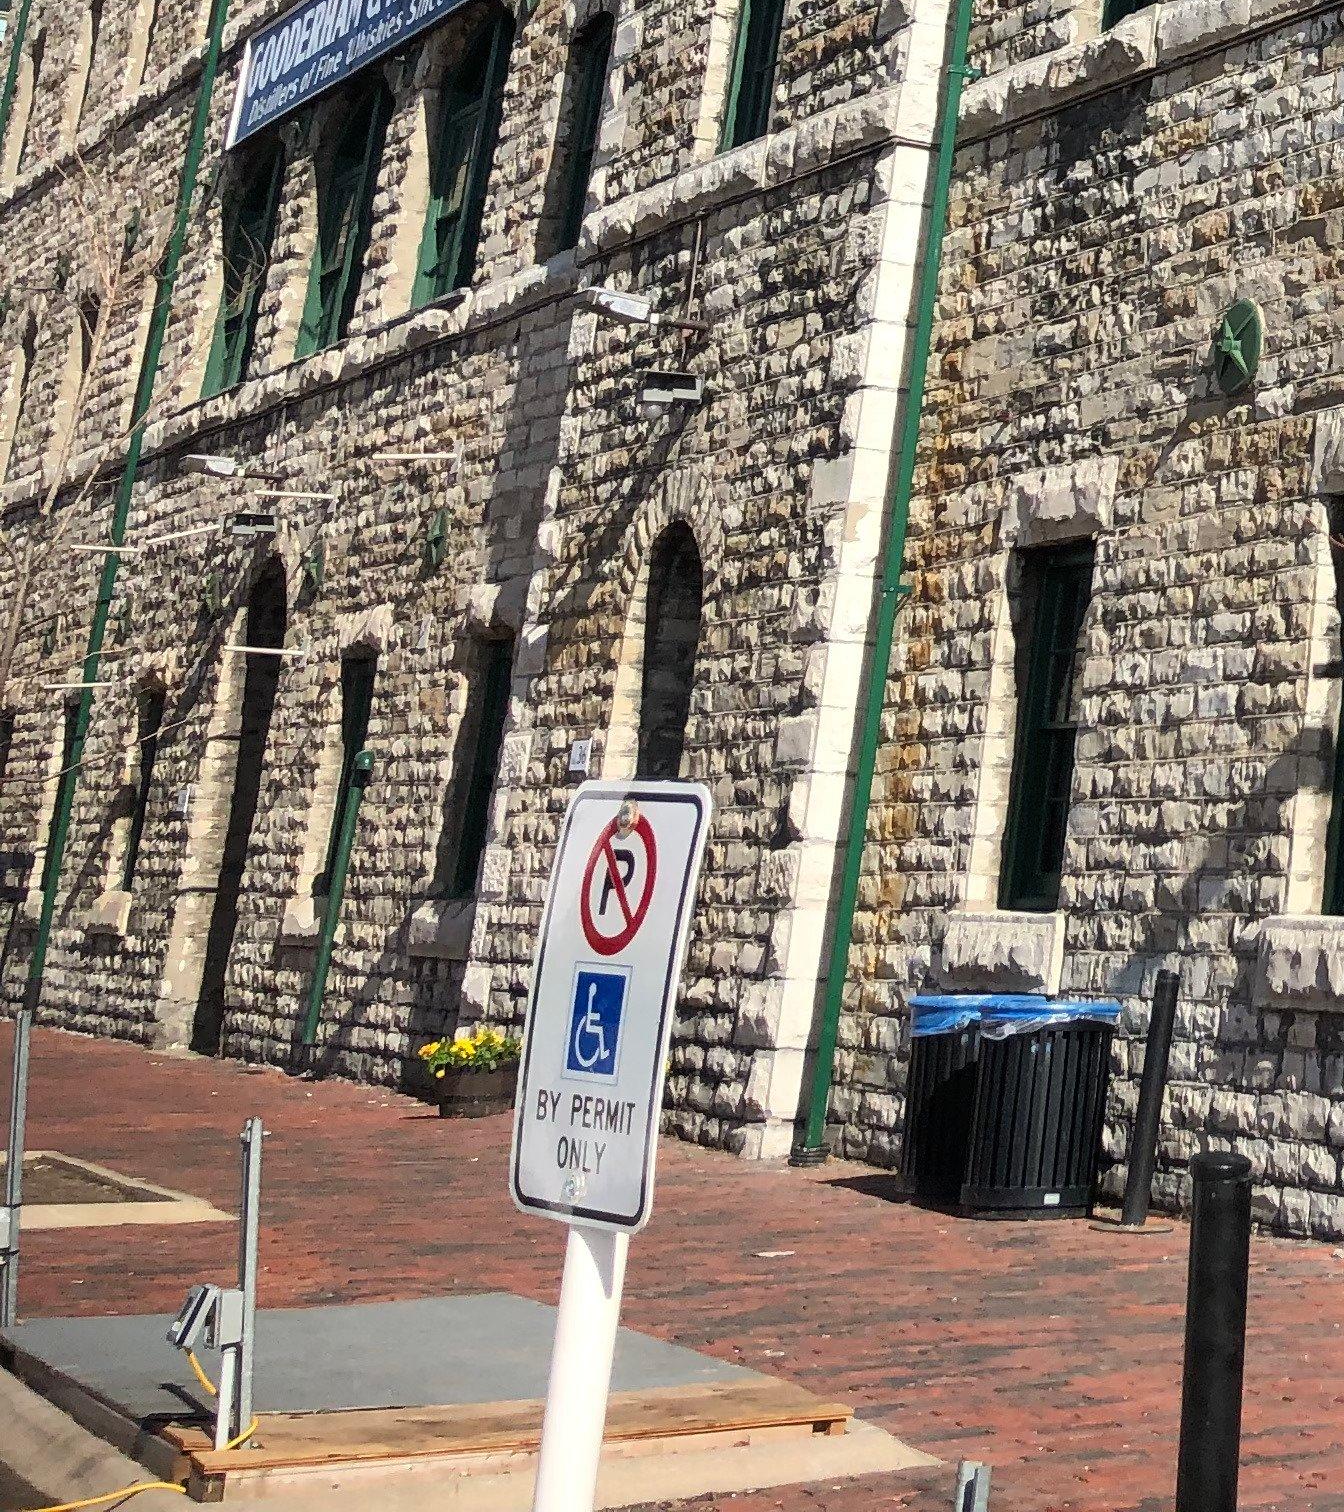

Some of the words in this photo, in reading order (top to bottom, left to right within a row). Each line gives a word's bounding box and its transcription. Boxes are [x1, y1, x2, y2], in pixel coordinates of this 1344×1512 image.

[313, 52, 343, 85] Fine
[536, 1089, 562, 1122] BY
[570, 1094, 635, 1135] PERMIT
[557, 1136, 607, 1175] ONLY
